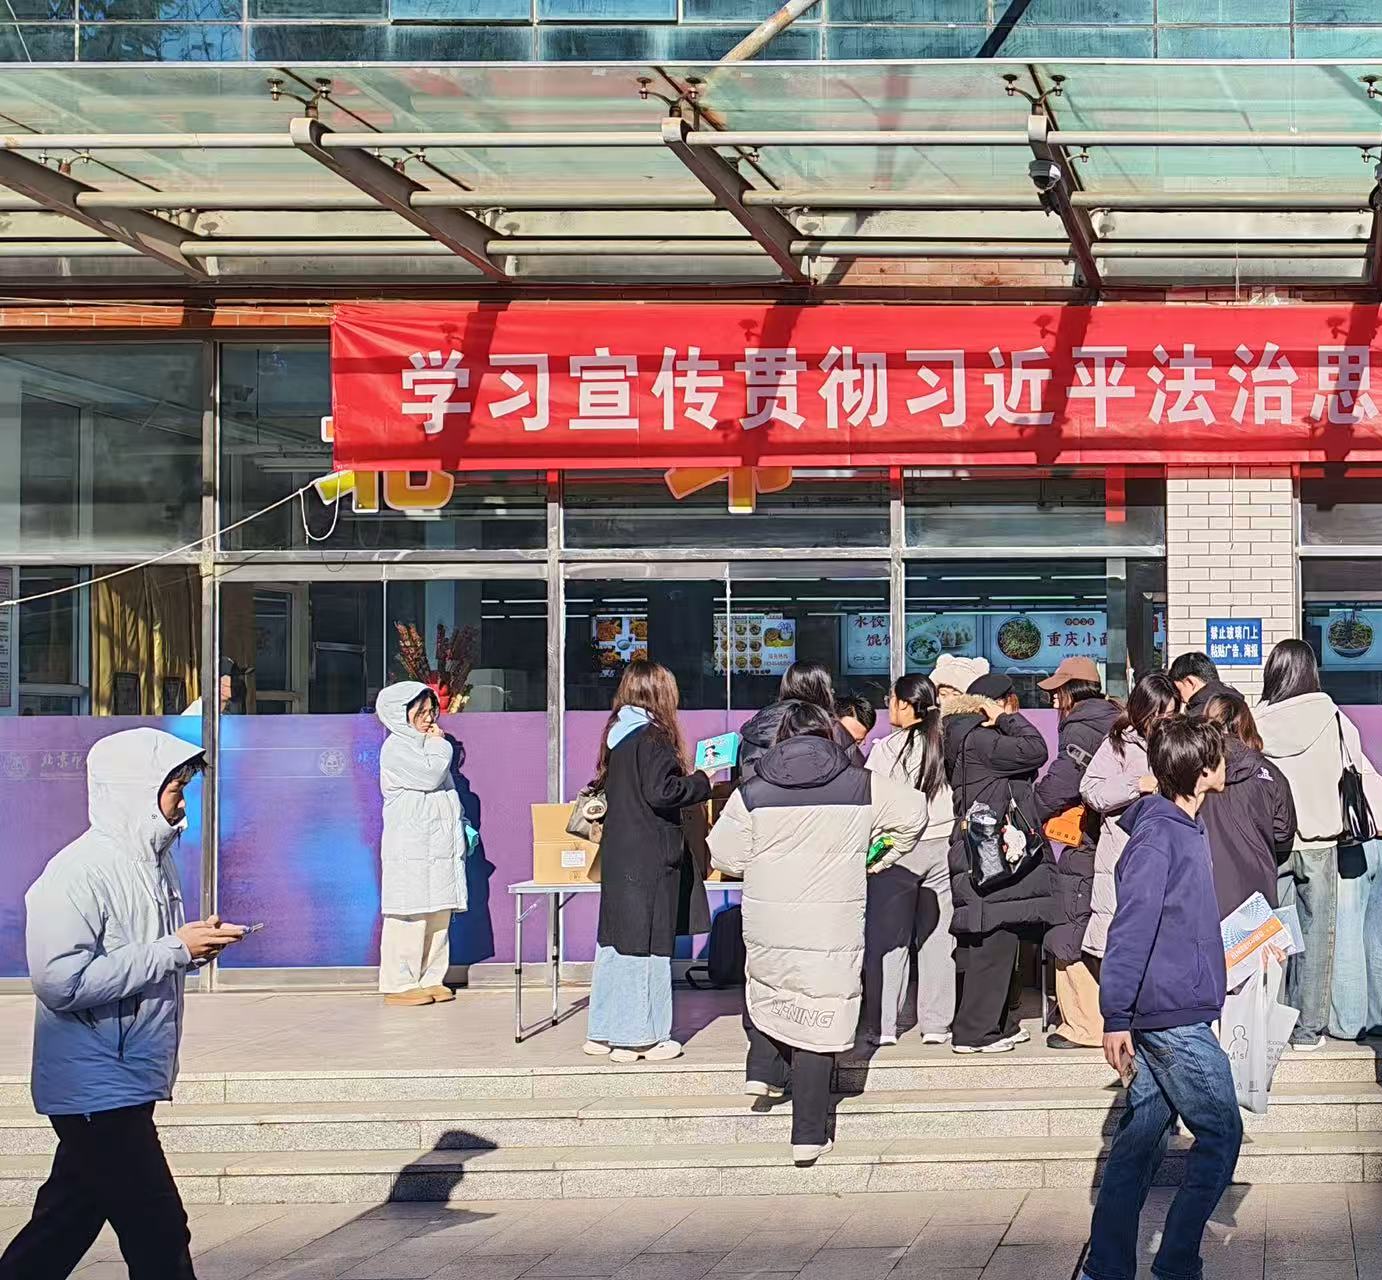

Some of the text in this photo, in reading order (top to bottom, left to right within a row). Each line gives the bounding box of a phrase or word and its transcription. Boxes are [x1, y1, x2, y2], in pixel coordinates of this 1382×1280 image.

[1210, 625, 1258, 640] 禁止玻璃门上
